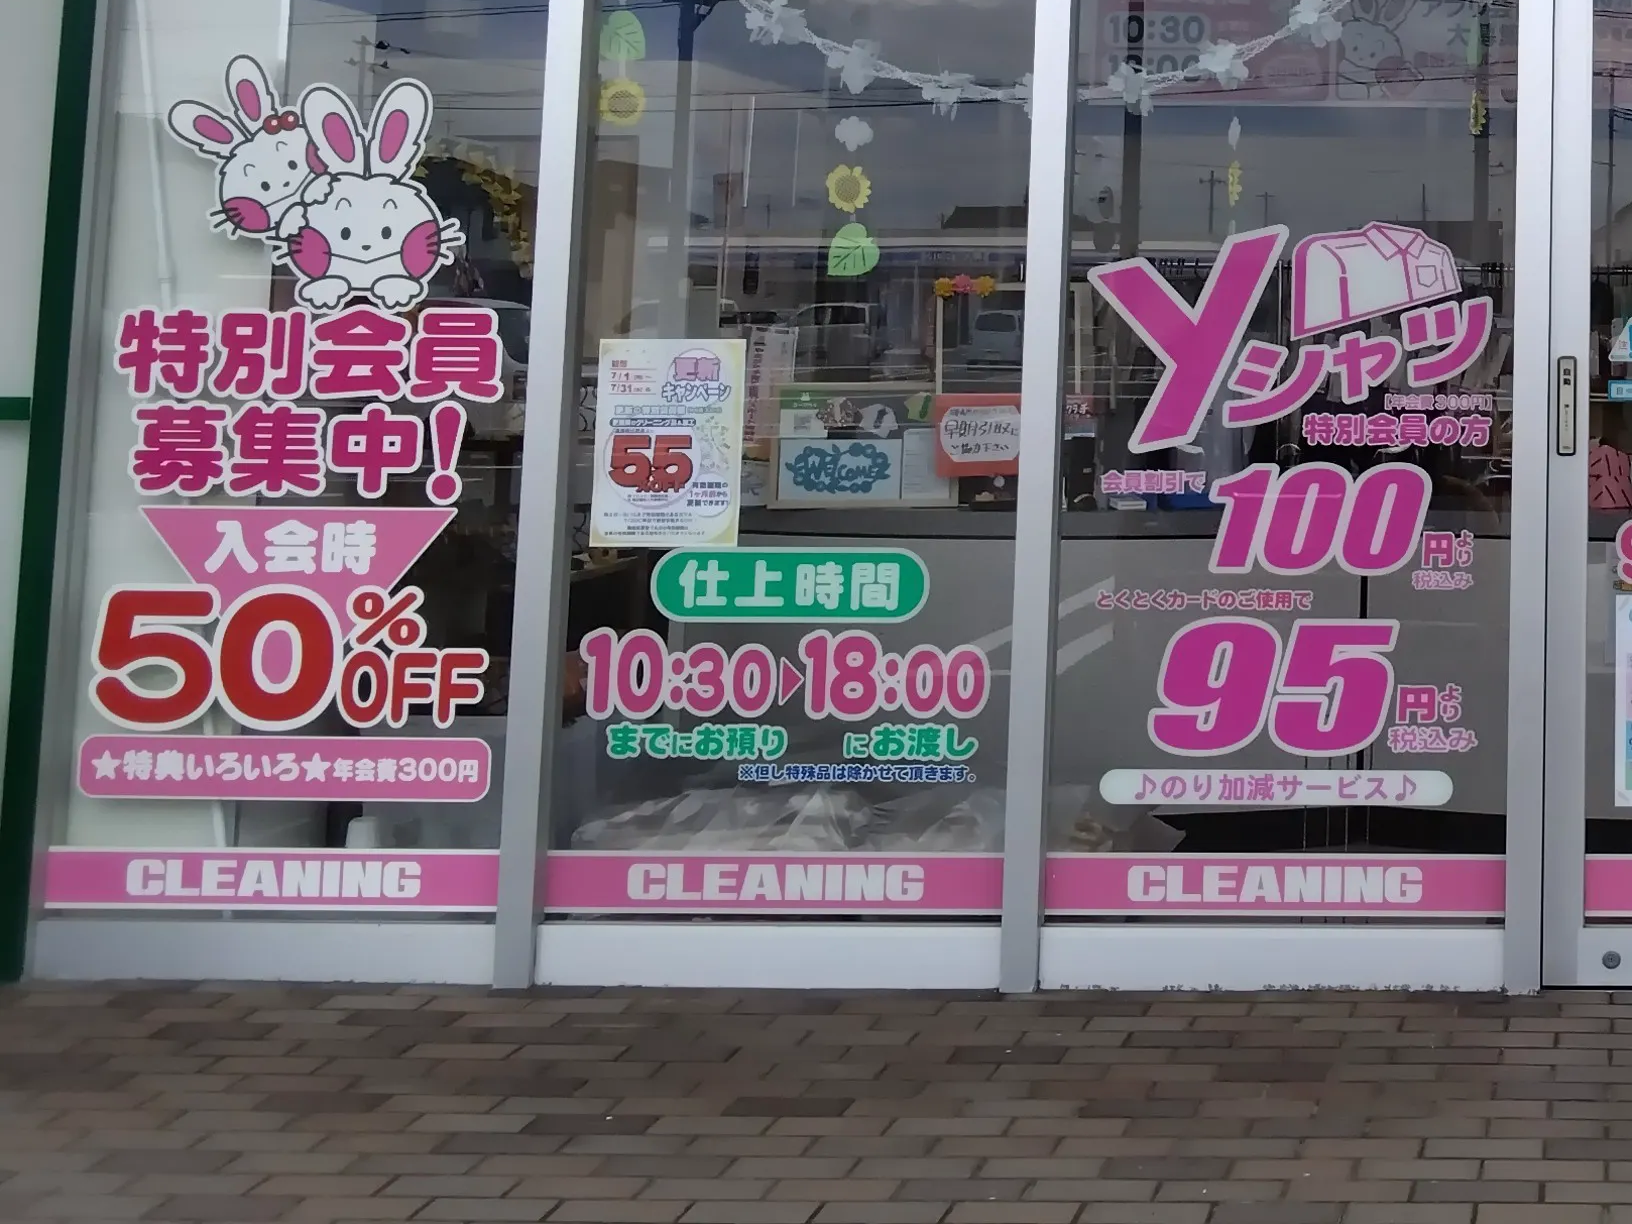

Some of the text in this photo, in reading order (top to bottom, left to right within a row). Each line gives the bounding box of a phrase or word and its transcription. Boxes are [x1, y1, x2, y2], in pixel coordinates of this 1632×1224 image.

[1108, 14, 1204, 43] 10:30
[117, 308, 501, 399] 特別会員
[1090, 226, 1490, 452] Yシャツ
[662, 382, 731, 403] キャンペーン
[1304, 414, 1492, 445] 特別会員の方
[134, 404, 465, 503] 募集中!
[1100, 470, 1206, 494] 会員割引で
[1211, 463, 1431, 573] 100
[205, 520, 377, 574] 入会時
[679, 560, 901, 611] 仕上時間
[1412, 571, 1473, 590] 税込み
[1096, 590, 1312, 610] とくとくカードのご使用で
[339, 649, 487, 727] OFF
[583, 630, 988, 718] 10:30 18:00
[1149, 618, 1398, 755] 95
[608, 723, 788, 759] までにお預り
[844, 725, 979, 760] にお渡し
[1388, 727, 1477, 752] 税込み
[738, 764, 976, 783] ※但し特殊品は除かせて頂きます。
[125, 859, 421, 898] CLEANING
[626, 863, 925, 901] CLEANING
[1127, 865, 1424, 904] CLEANING
